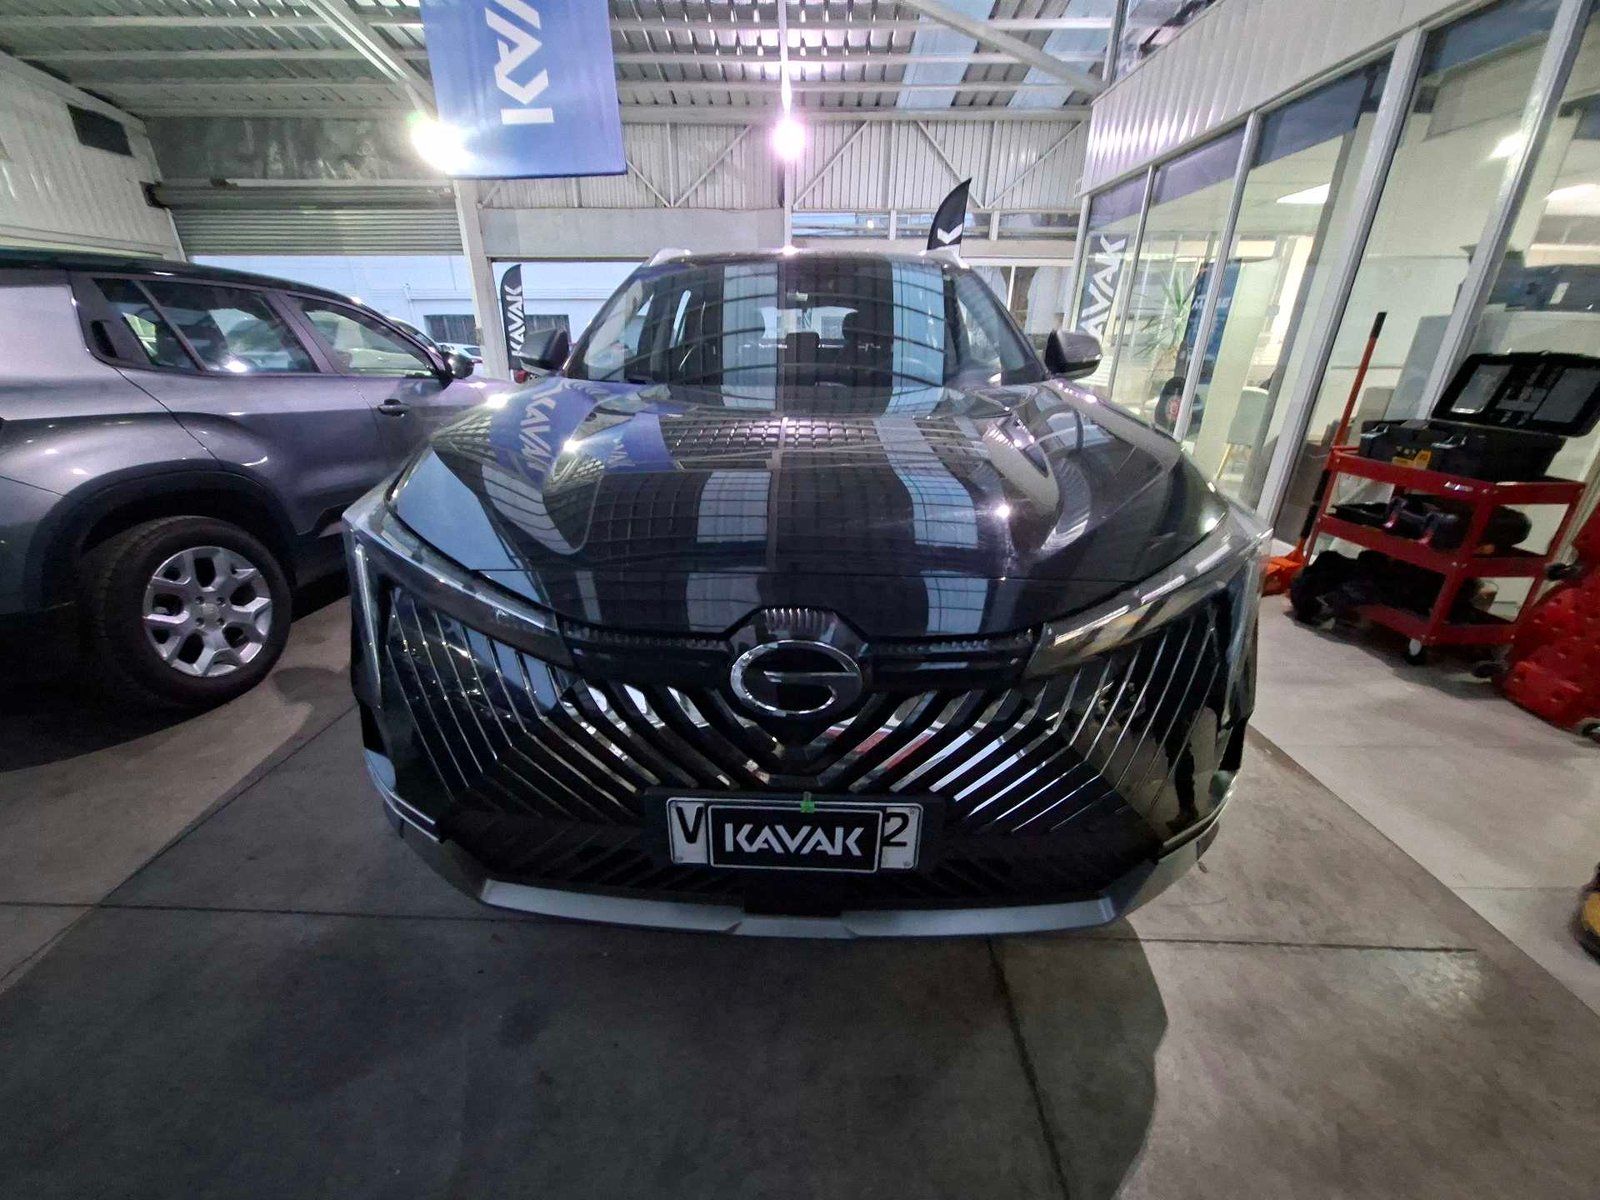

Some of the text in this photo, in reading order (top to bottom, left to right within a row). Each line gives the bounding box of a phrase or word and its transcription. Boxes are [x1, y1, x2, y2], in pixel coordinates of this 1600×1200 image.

[504, 285, 526, 357] KAVAK
[1080, 234, 1126, 345] AVAK
[676, 806, 910, 857] V KAVAK 2
